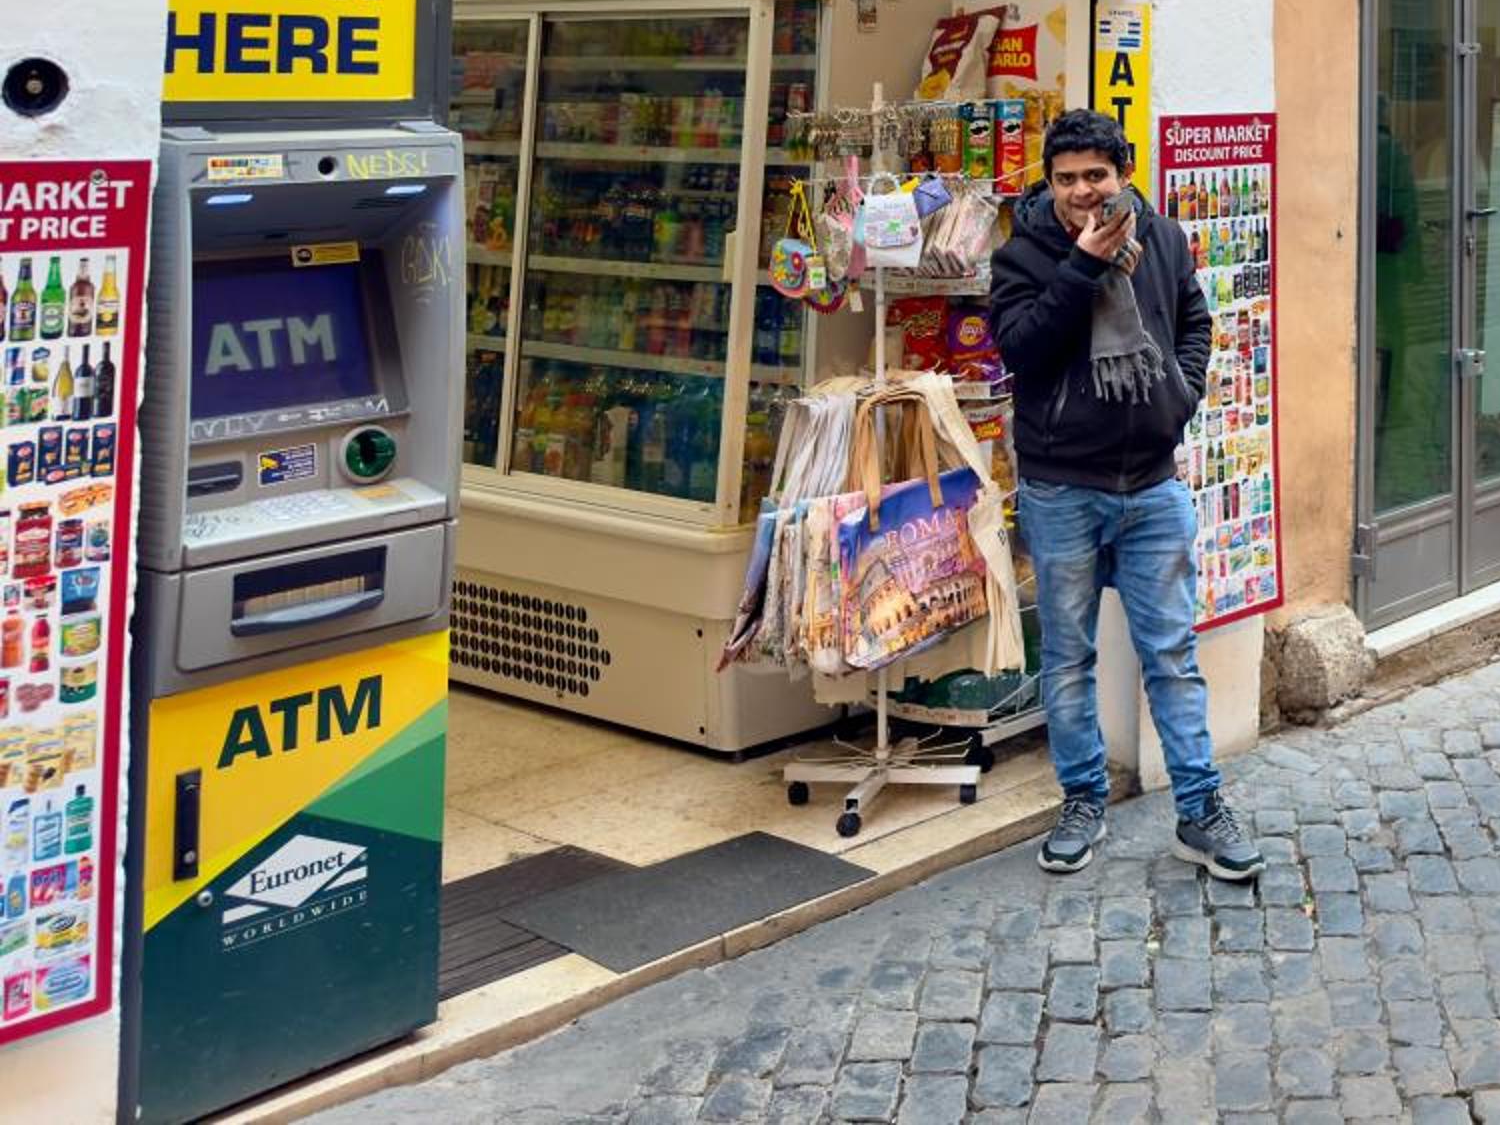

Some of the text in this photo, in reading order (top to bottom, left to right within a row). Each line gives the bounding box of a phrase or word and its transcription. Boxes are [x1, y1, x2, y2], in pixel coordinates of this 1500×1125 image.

[164, 11, 381, 75] HERE
[1165, 123, 1273, 147] SUPER MARKET
[1174, 143, 1264, 163] DISCOUNT PRICE
[0, 180, 134, 212] ARKET
[20, 215, 107, 240] PRICE
[204, 313, 337, 376] ATM
[216, 674, 383, 770] ATM
[250, 851, 346, 895] Euronet
[222, 889, 368, 947] WORLDWIDE
